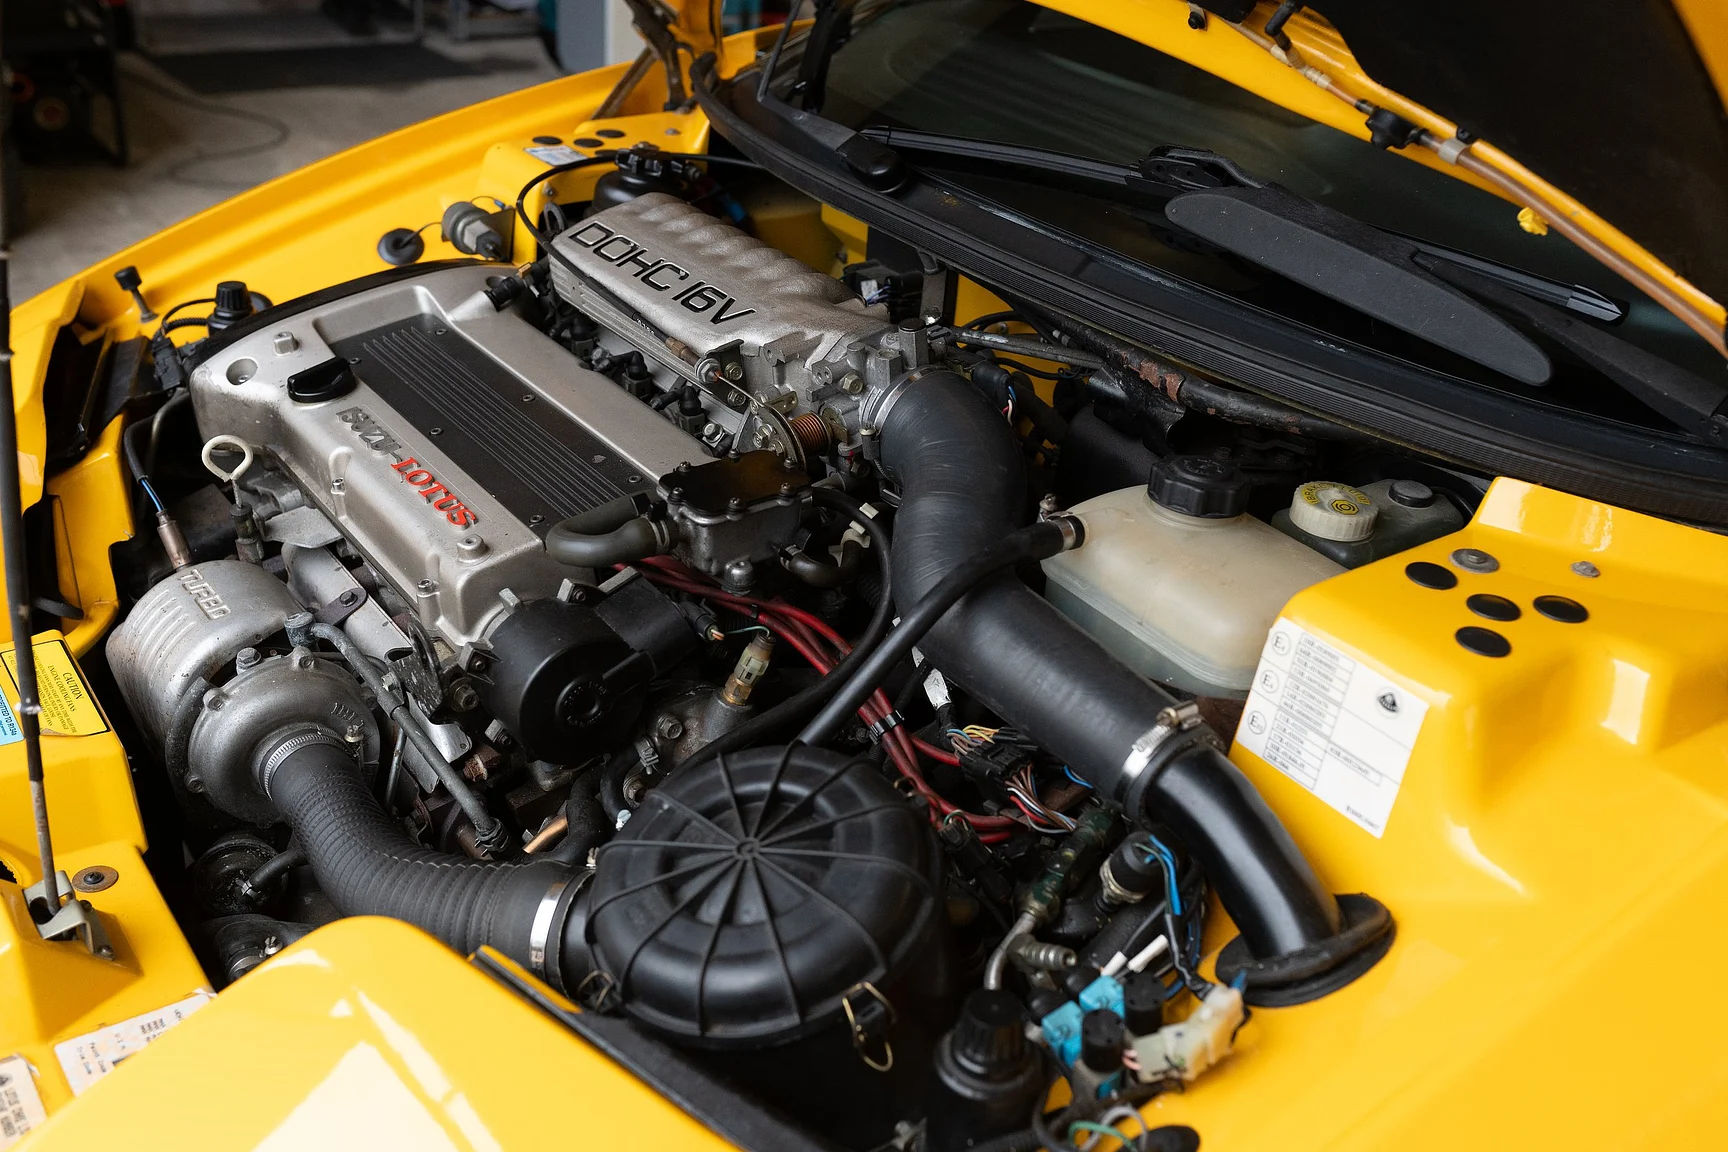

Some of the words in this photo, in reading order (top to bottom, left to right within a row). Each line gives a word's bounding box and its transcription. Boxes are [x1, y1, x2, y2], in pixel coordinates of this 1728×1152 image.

[569, 220, 690, 292] DOHC
[671, 280, 756, 325] 16V
[178, 569, 231, 620] TURBO
[46, 664, 61, 681] ENGINE
[54, 680, 71, 700] COOLING
[64, 698, 77, 712] FANS
[62, 671, 84, 699] CAUTION
